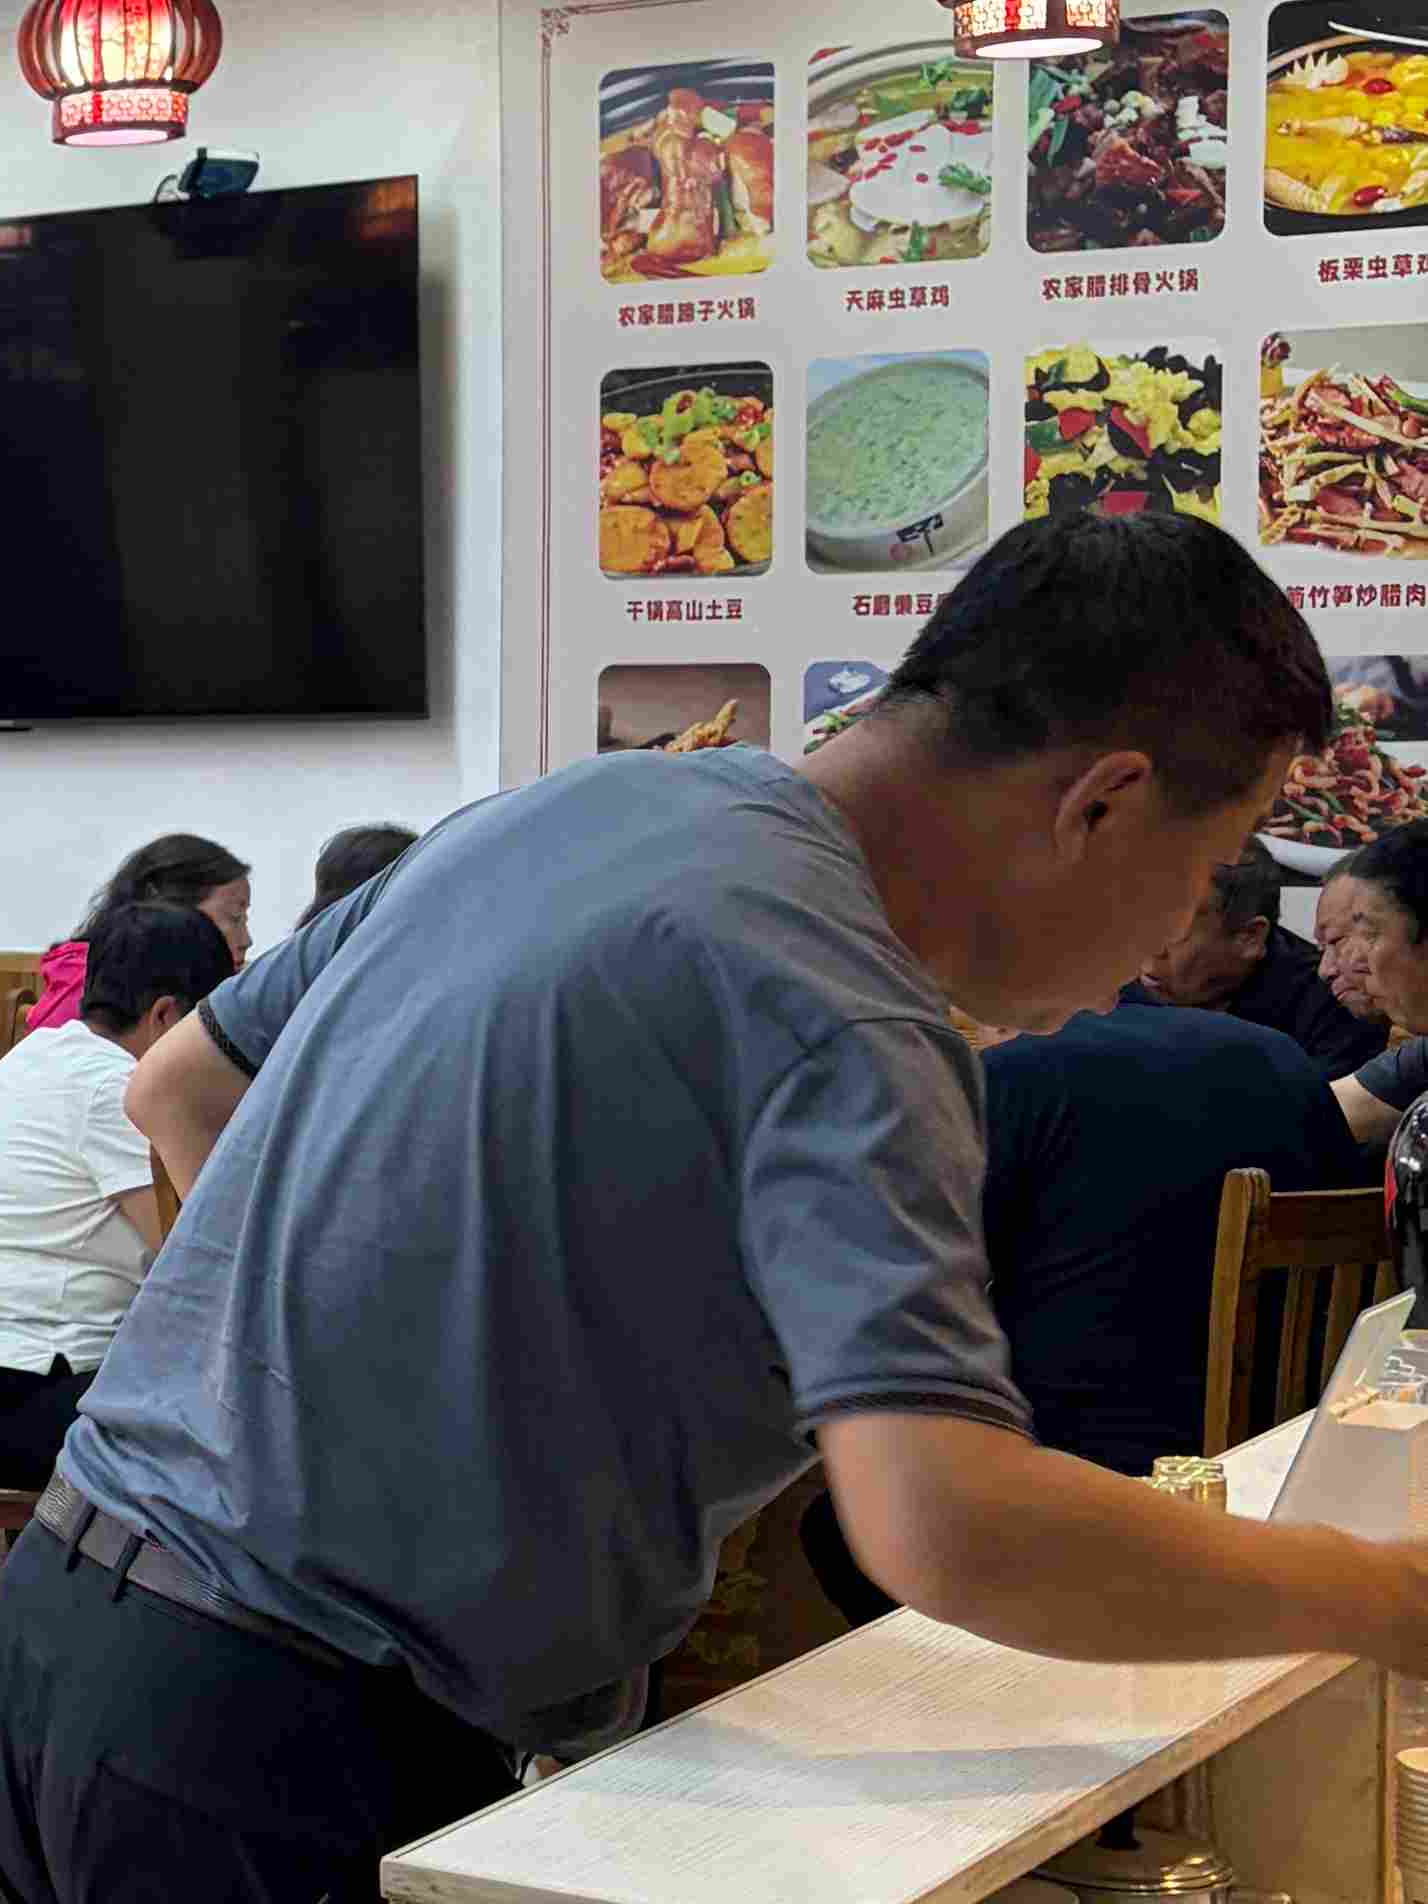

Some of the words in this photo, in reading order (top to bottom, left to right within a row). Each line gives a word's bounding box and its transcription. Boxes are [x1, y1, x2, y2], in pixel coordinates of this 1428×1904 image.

[1042, 268, 1199, 300] 农家腊排骨火锅
[846, 285, 949, 312] 天麻虫草鸡
[626, 599, 743, 621] 干锅高山土豆
[853, 593, 951, 616] 石磨懒豆
